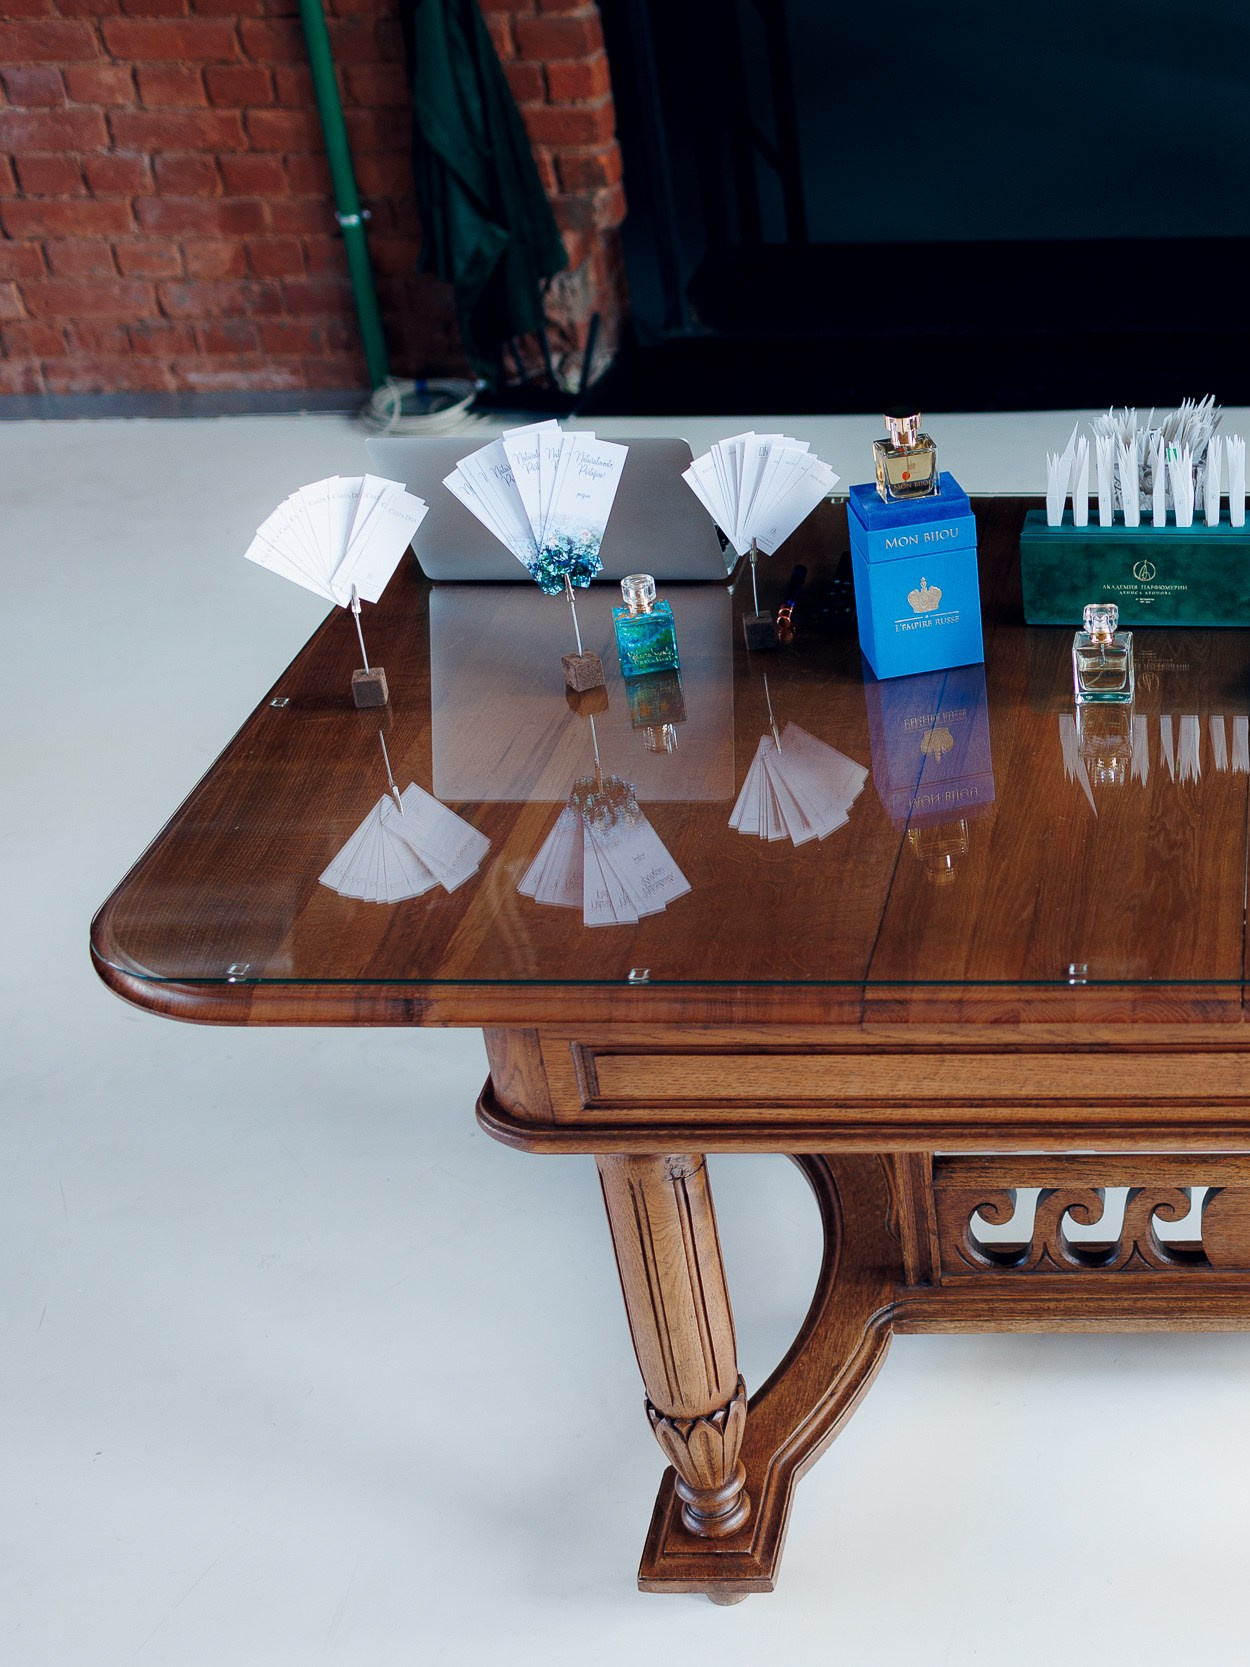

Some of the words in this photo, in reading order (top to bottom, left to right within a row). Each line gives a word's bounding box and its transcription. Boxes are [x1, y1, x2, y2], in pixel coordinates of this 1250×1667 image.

[885, 534, 919, 550] MON
[924, 527, 959, 543] BIJOU
[895, 620, 933, 633] L'EMPIRE
[935, 615, 960, 626] RUSSE
